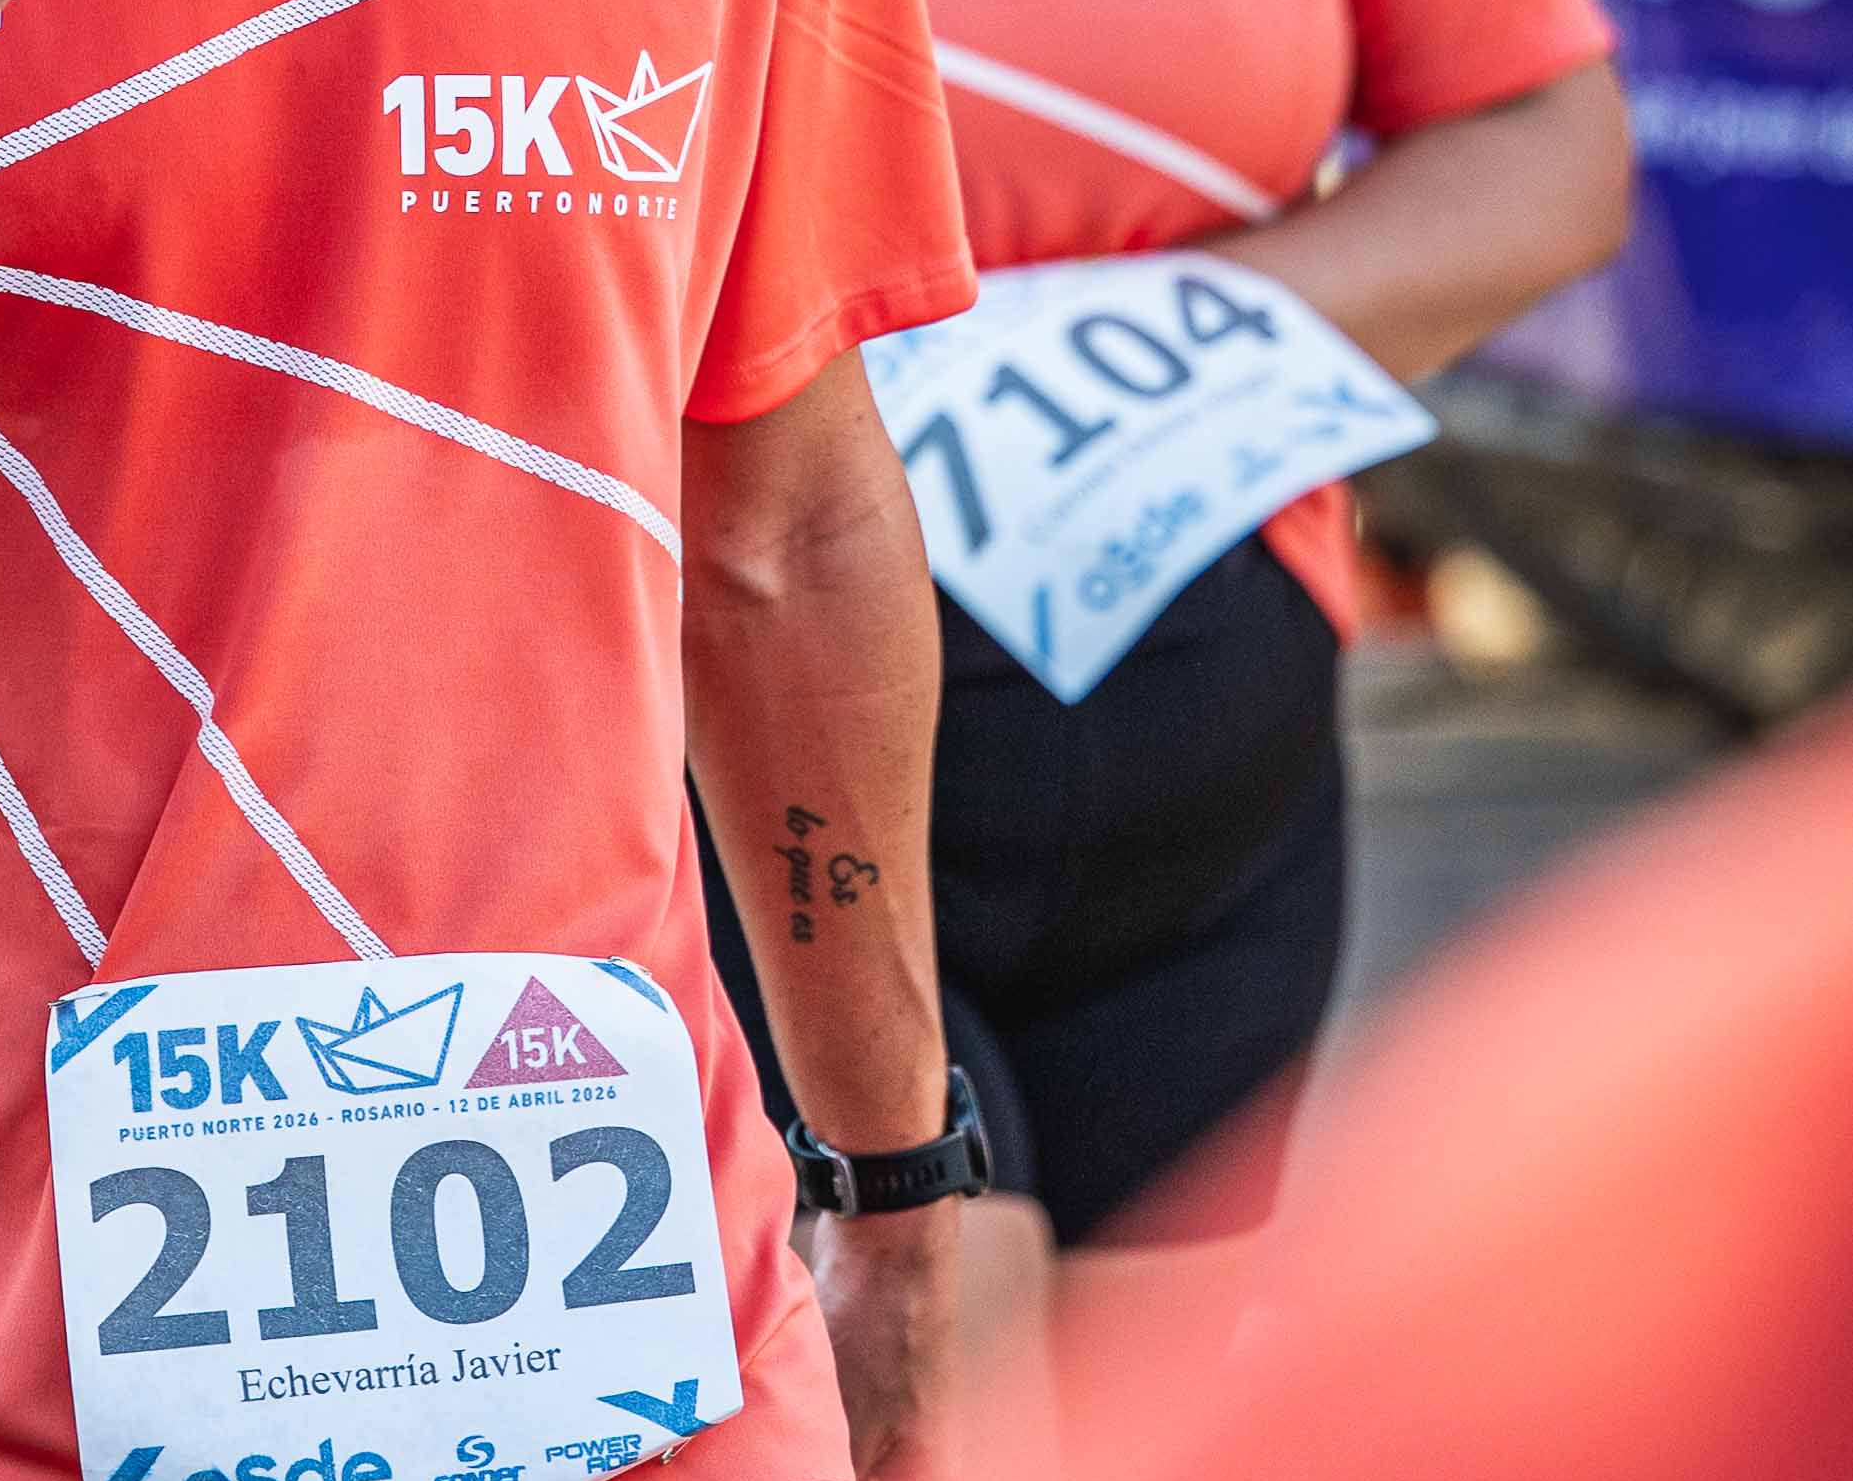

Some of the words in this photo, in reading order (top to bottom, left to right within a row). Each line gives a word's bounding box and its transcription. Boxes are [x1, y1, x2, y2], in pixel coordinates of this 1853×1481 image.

[382, 74, 574, 177] 15K
[903, 272, 1278, 557] 7104
[112, 1020, 289, 1113] 15K
[499, 1022, 588, 1070] 15K
[119, 1122, 195, 1143] PUERTO
[202, 1116, 265, 1136] NORTE
[273, 1111, 319, 1129] 2026
[341, 1102, 425, 1124] ROSARIO
[448, 1098, 469, 1114] 12
[477, 1095, 501, 1112] DE
[508, 1091, 564, 1109] ABRIL
[572, 1086, 617, 1103] 2026
[89, 1126, 696, 1355] 2102
[237, 1353, 440, 1403] Echevarría
[451, 1342, 562, 1383] Javier
[545, 1434, 642, 1463] POWER
[586, 1451, 640, 1474] ADE
